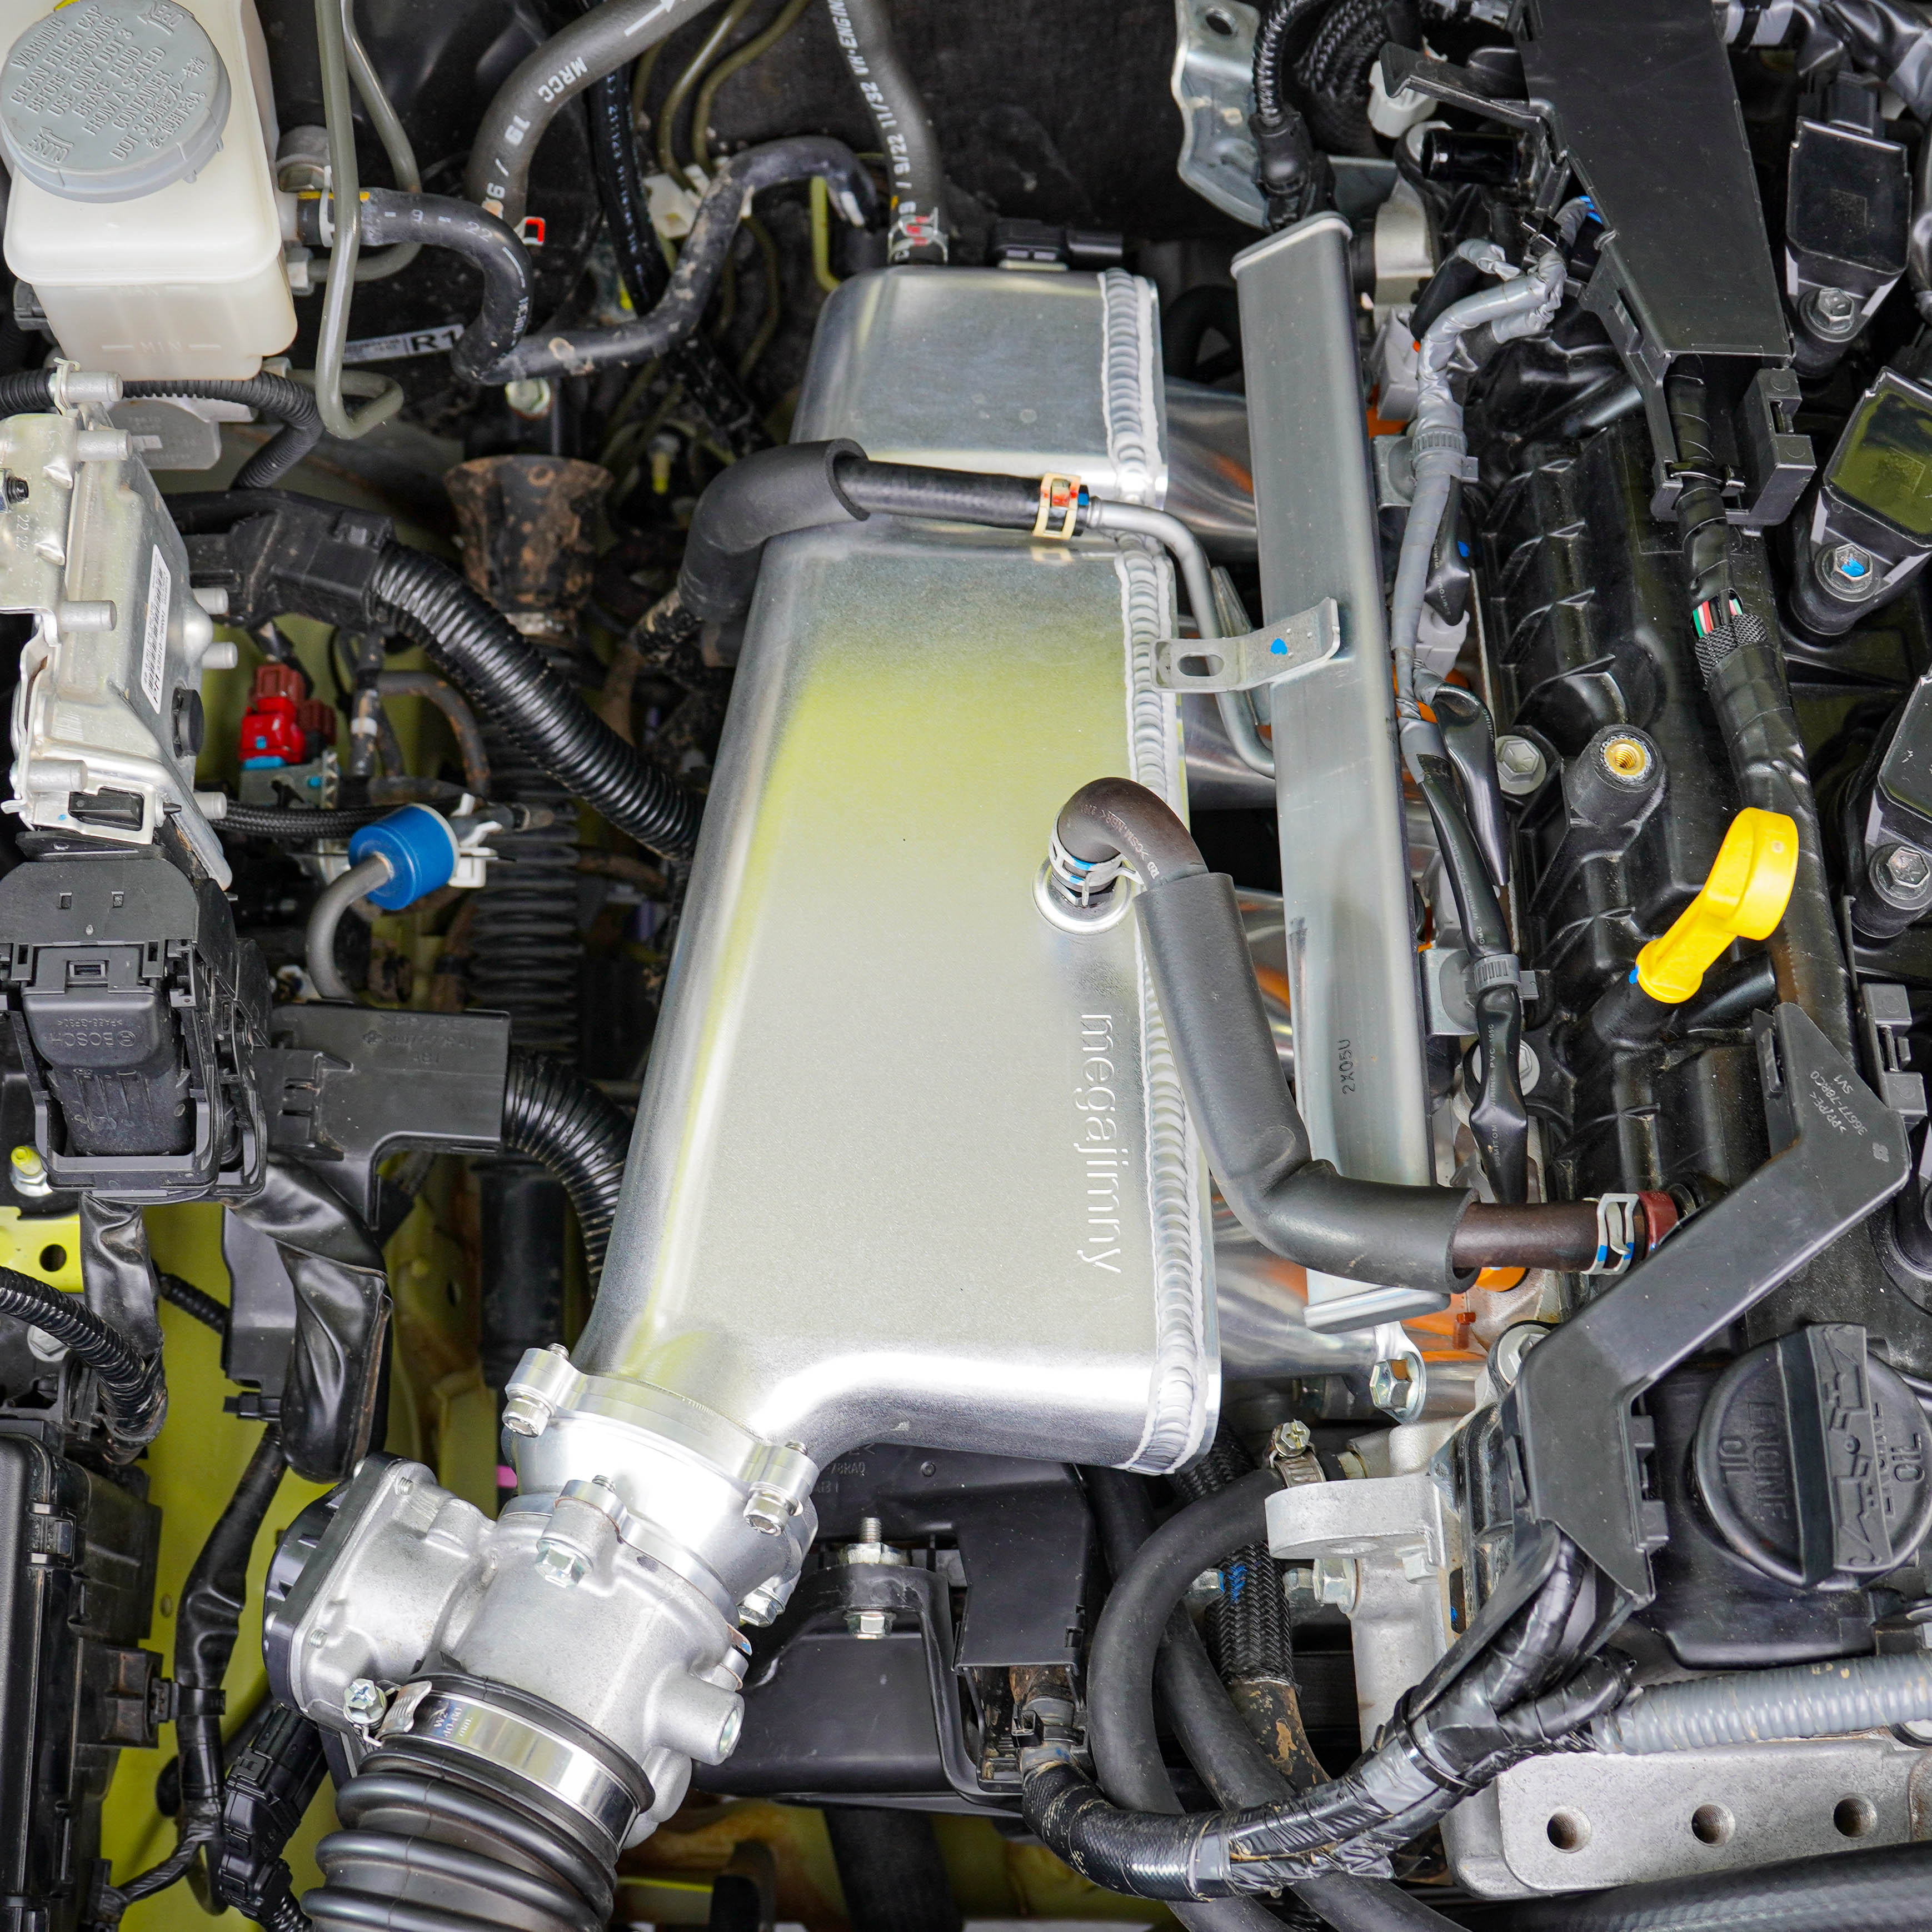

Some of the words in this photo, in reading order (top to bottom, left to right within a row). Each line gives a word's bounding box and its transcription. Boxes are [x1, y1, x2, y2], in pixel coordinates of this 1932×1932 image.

[9, 65, 51, 104] CLEAN
[42, 29, 84, 67] FILLER
[76, 4, 102, 30] CAP
[10, 17, 67, 69] WARNING
[47, 91, 77, 117] USE
[69, 61, 102, 93] ONLY
[95, 36, 124, 64] DOT
[71, 79, 114, 118] BRAKE
[107, 46, 143, 79] FLUID
[121, 46, 166, 91] SEALED
[537, 56, 588, 102] MRCC
[24, 71, 68, 115] BEFORE
[112, 90, 131, 104] A
[82, 100, 119, 136] FROM
[504, 114, 531, 146] 19
[109, 134, 139, 161] DOT
[132, 123, 149, 136] 3
[463, 221, 494, 243] 22
[140, 341, 183, 353] MIN
[1481, 708, 1495, 742] WIRING
[1466, 888, 1479, 921] WIRING
[44, 1031, 115, 1047] BOSCH
[1833, 1074, 1854, 1095] SV1
[1073, 1014, 1129, 1274] megajimny
[1718, 1434, 1751, 1485] OIL
[1747, 1401, 1789, 1520] ENGINE
[1891, 1432, 1926, 1482] OIL
